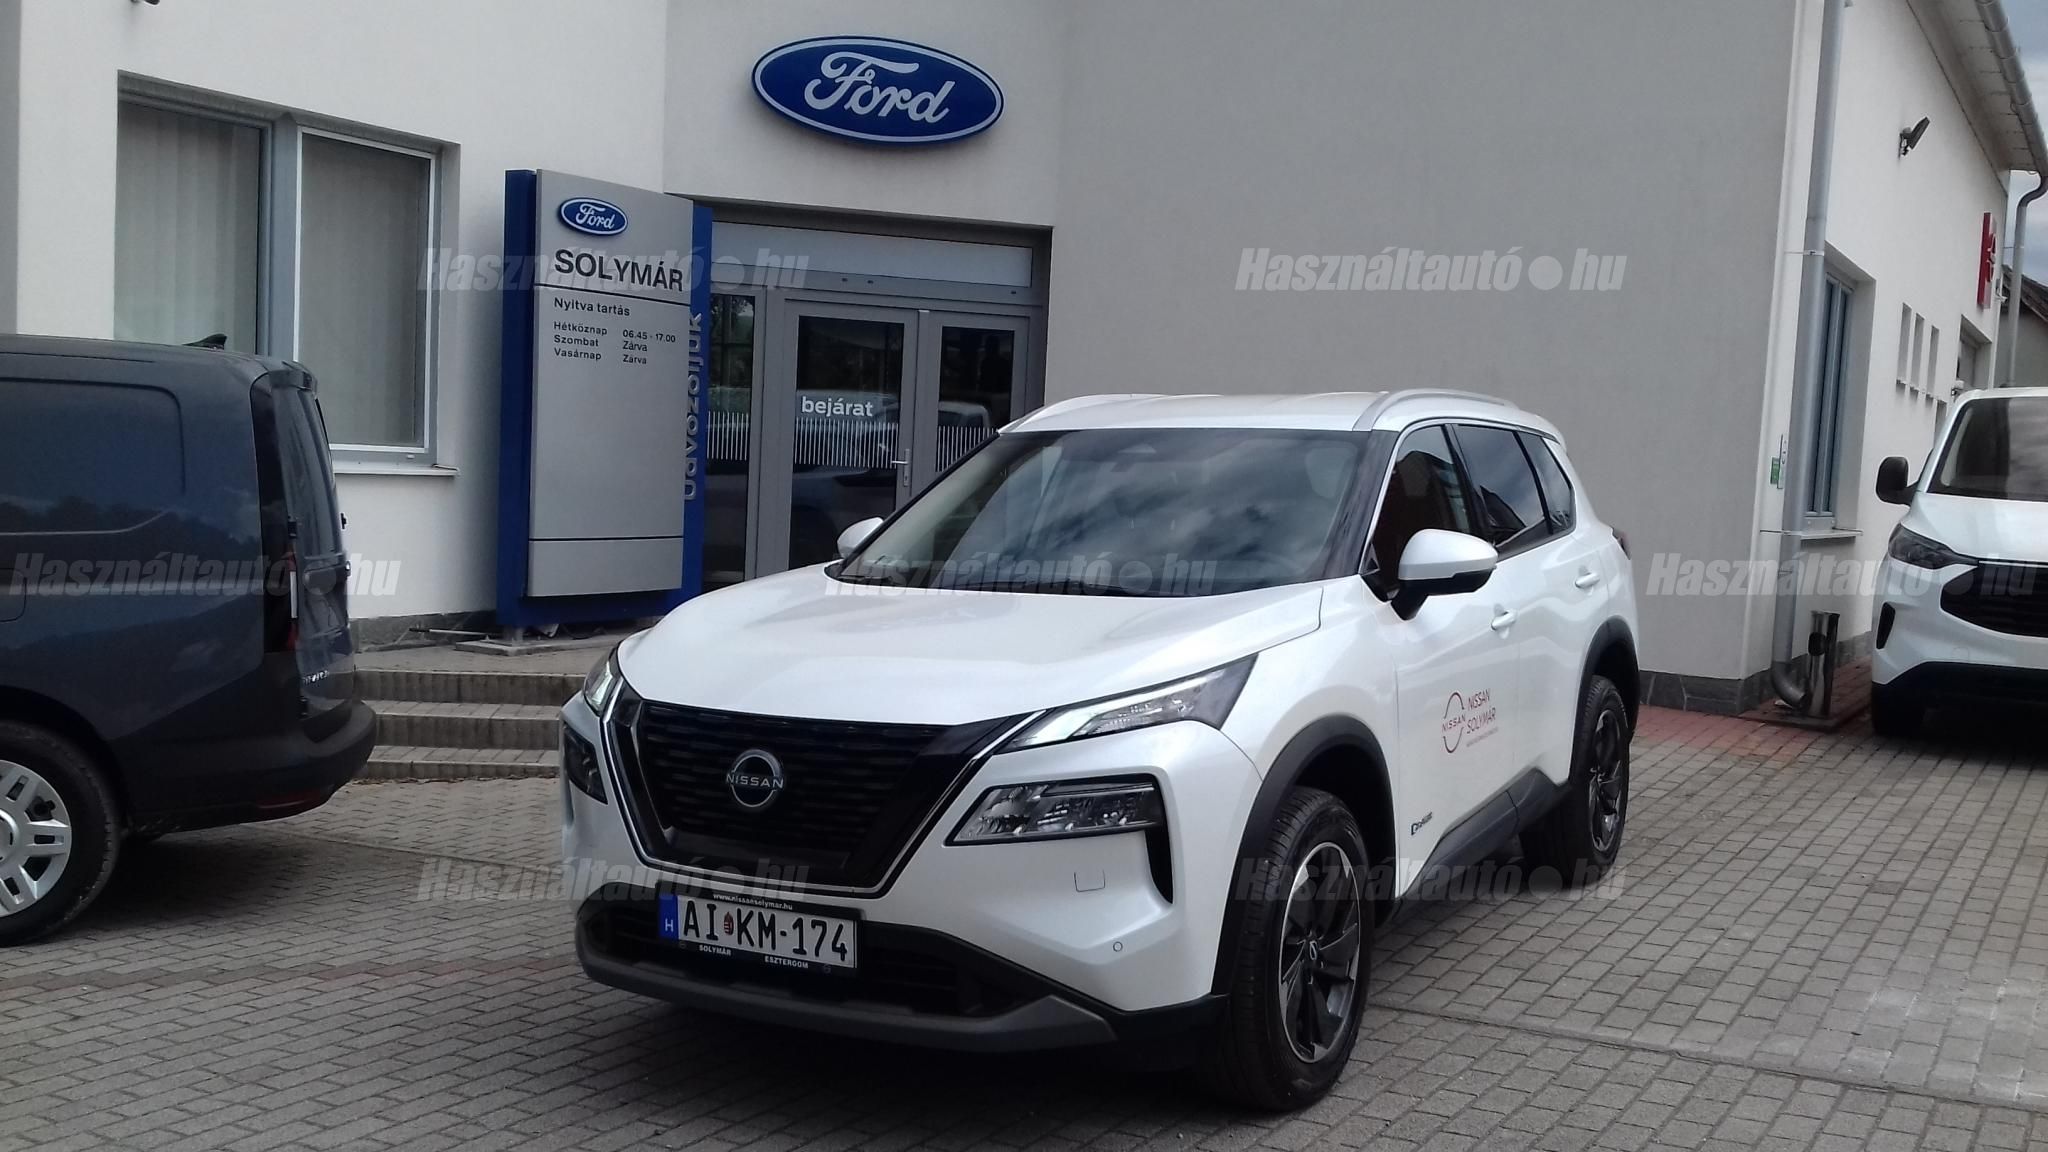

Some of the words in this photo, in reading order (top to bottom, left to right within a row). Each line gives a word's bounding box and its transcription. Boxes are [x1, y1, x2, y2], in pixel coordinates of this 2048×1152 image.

[804, 51, 955, 123] Ford
[575, 203, 615, 229] Ford
[554, 249, 683, 292] SOLYMÁR
[554, 297, 594, 311] Nyitva
[597, 303, 630, 316] tartás
[554, 321, 608, 336] Hétköznap
[622, 329, 648, 340] 06.45
[655, 333, 676, 343] 17.00
[554, 335, 599, 347] Szombat
[622, 340, 648, 352] Zárva
[554, 347, 602, 361] Vasárnap
[802, 396, 873, 417] bejárat
[1468, 688, 1491, 711] NISSAN
[1442, 713, 1466, 732] NISSAN
[726, 773, 784, 789] NISSAN
[665, 918, 674, 932] H
[683, 900, 719, 941] AI
[736, 908, 848, 961] KM-174
